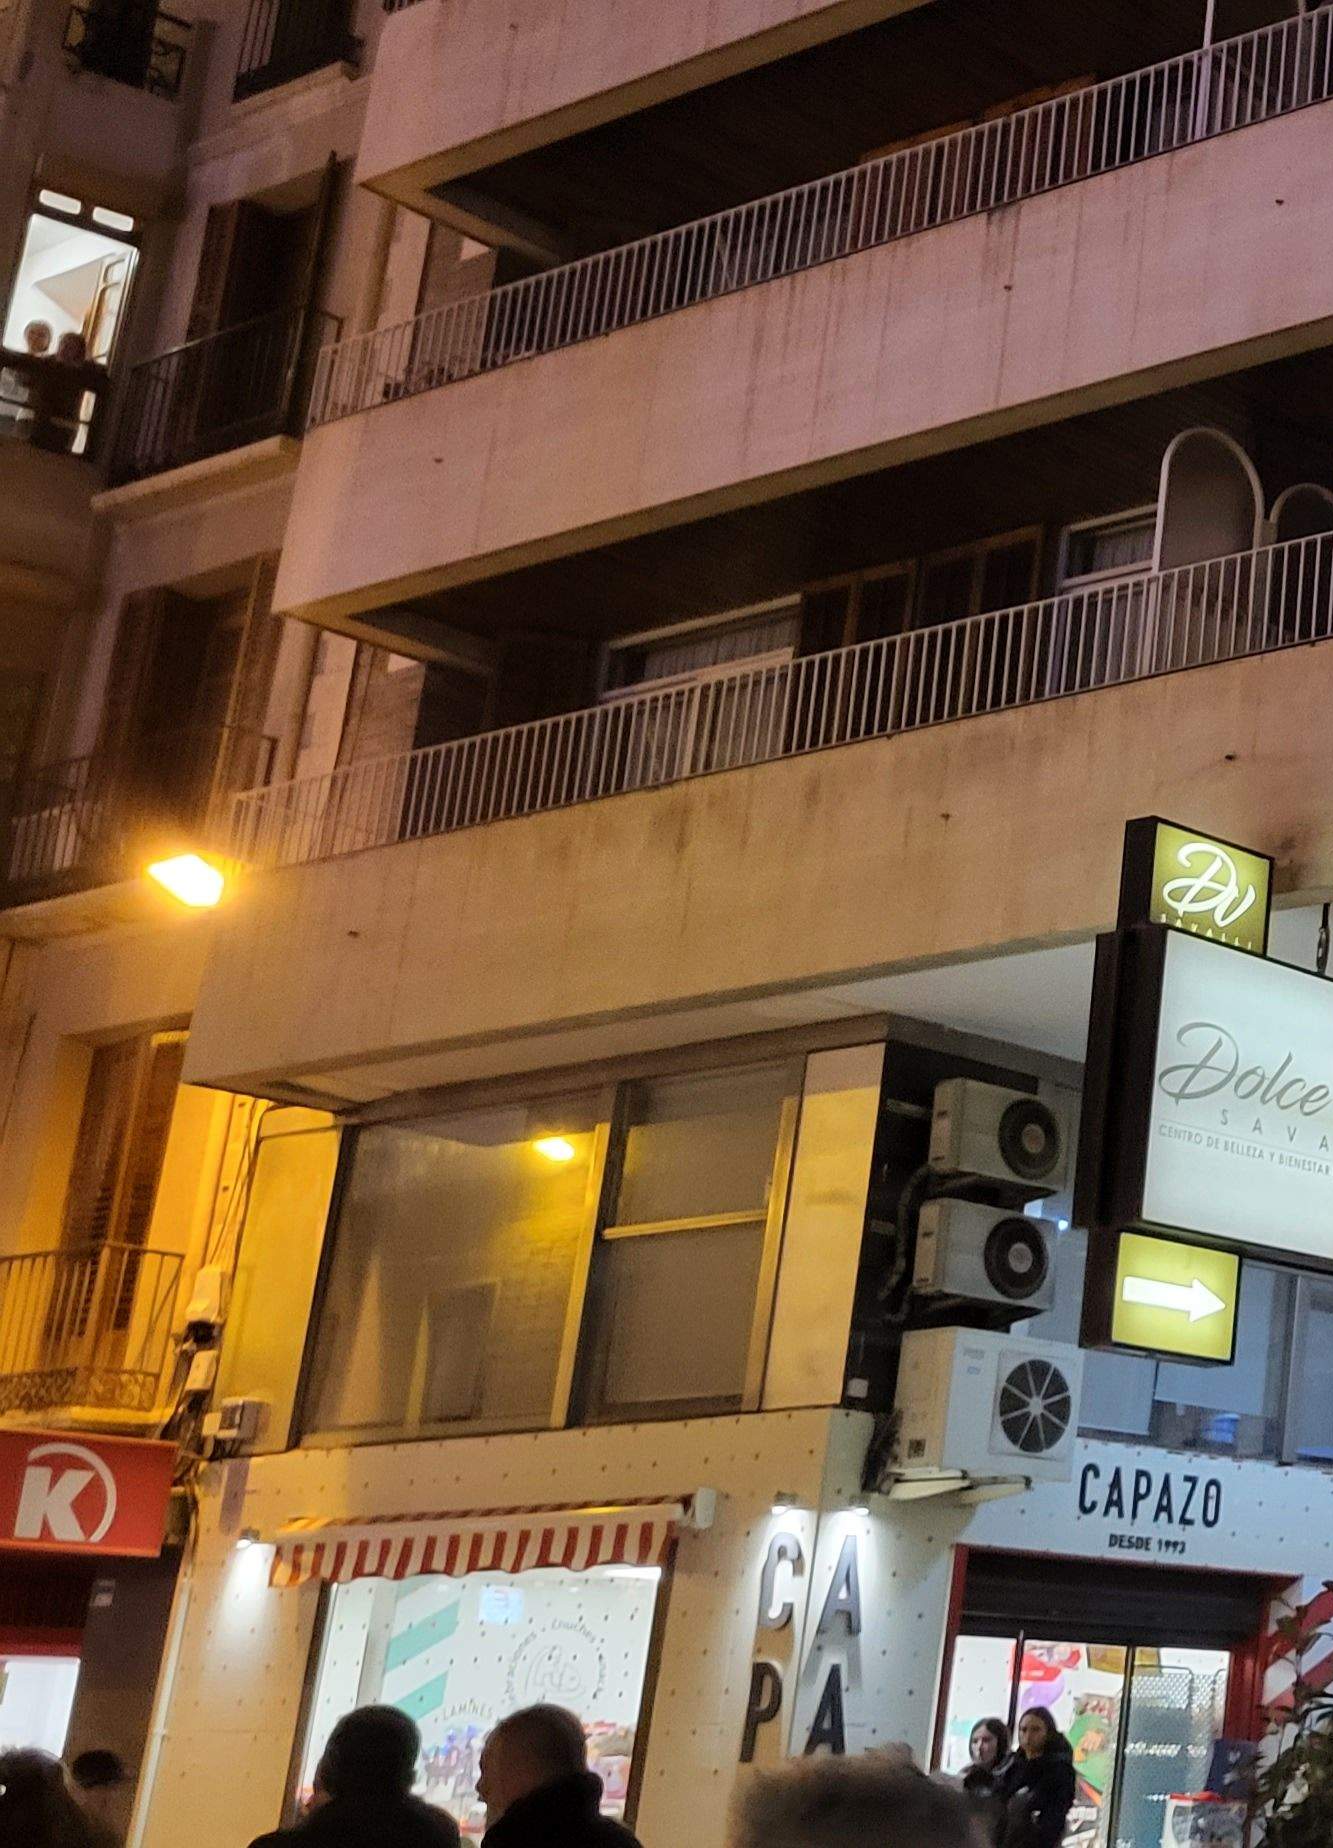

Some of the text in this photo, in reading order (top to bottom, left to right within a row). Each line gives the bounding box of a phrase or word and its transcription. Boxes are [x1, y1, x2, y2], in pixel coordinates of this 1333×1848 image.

[1158, 1021, 1333, 1117] Dolce
[1158, 1124, 1203, 1144] CENTRO
[1206, 1136, 1221, 1150] DE
[1223, 1141, 1265, 1161] BELLEZA
[1268, 1151, 1276, 1163] Y
[1278, 1154, 1330, 1176] BIENESTAR
[1078, 1462, 1221, 1528] CAPAZO
[1109, 1533, 1152, 1551] DESDE
